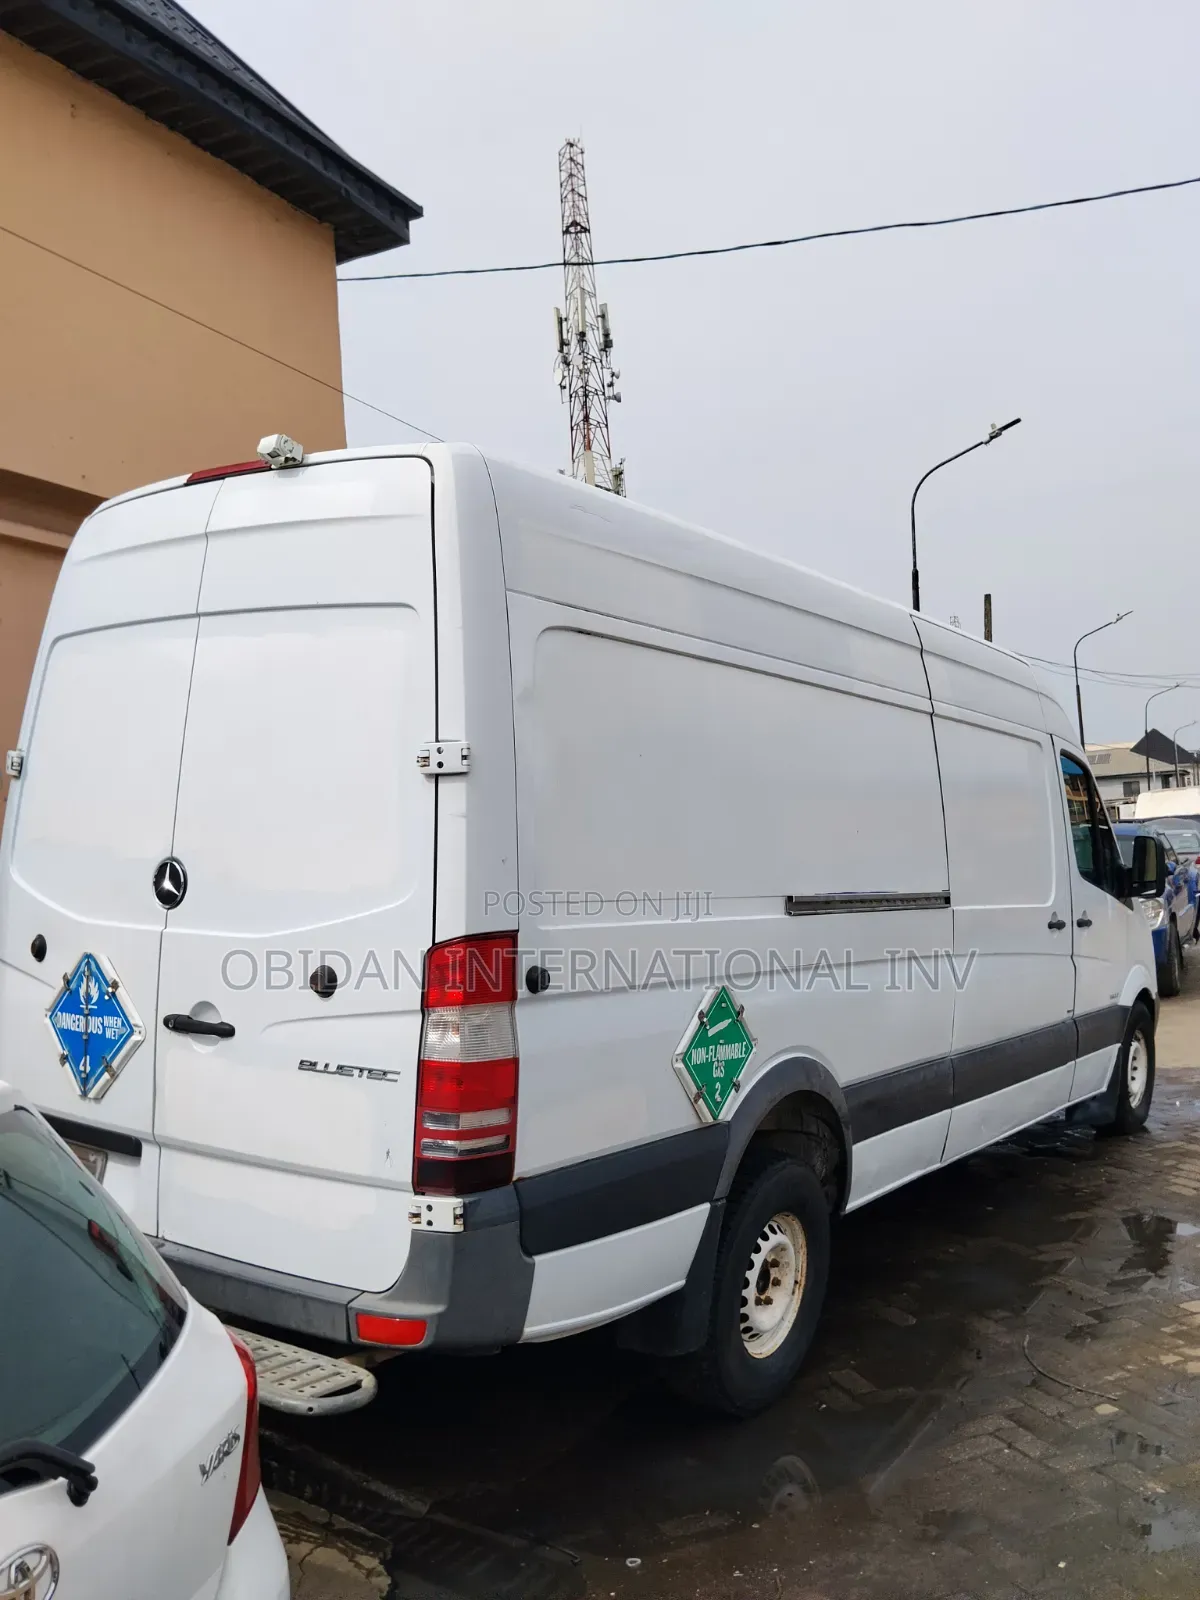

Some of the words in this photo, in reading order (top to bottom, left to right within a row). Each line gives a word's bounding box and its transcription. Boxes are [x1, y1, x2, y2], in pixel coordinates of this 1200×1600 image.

[103, 1015, 122, 1028] WHEN
[105, 1028, 119, 1040] WET
[691, 1042, 746, 1065] NON-FLAMMABLE
[298, 1059, 401, 1083] BLUETEC
[714, 1081, 722, 1102] 2
